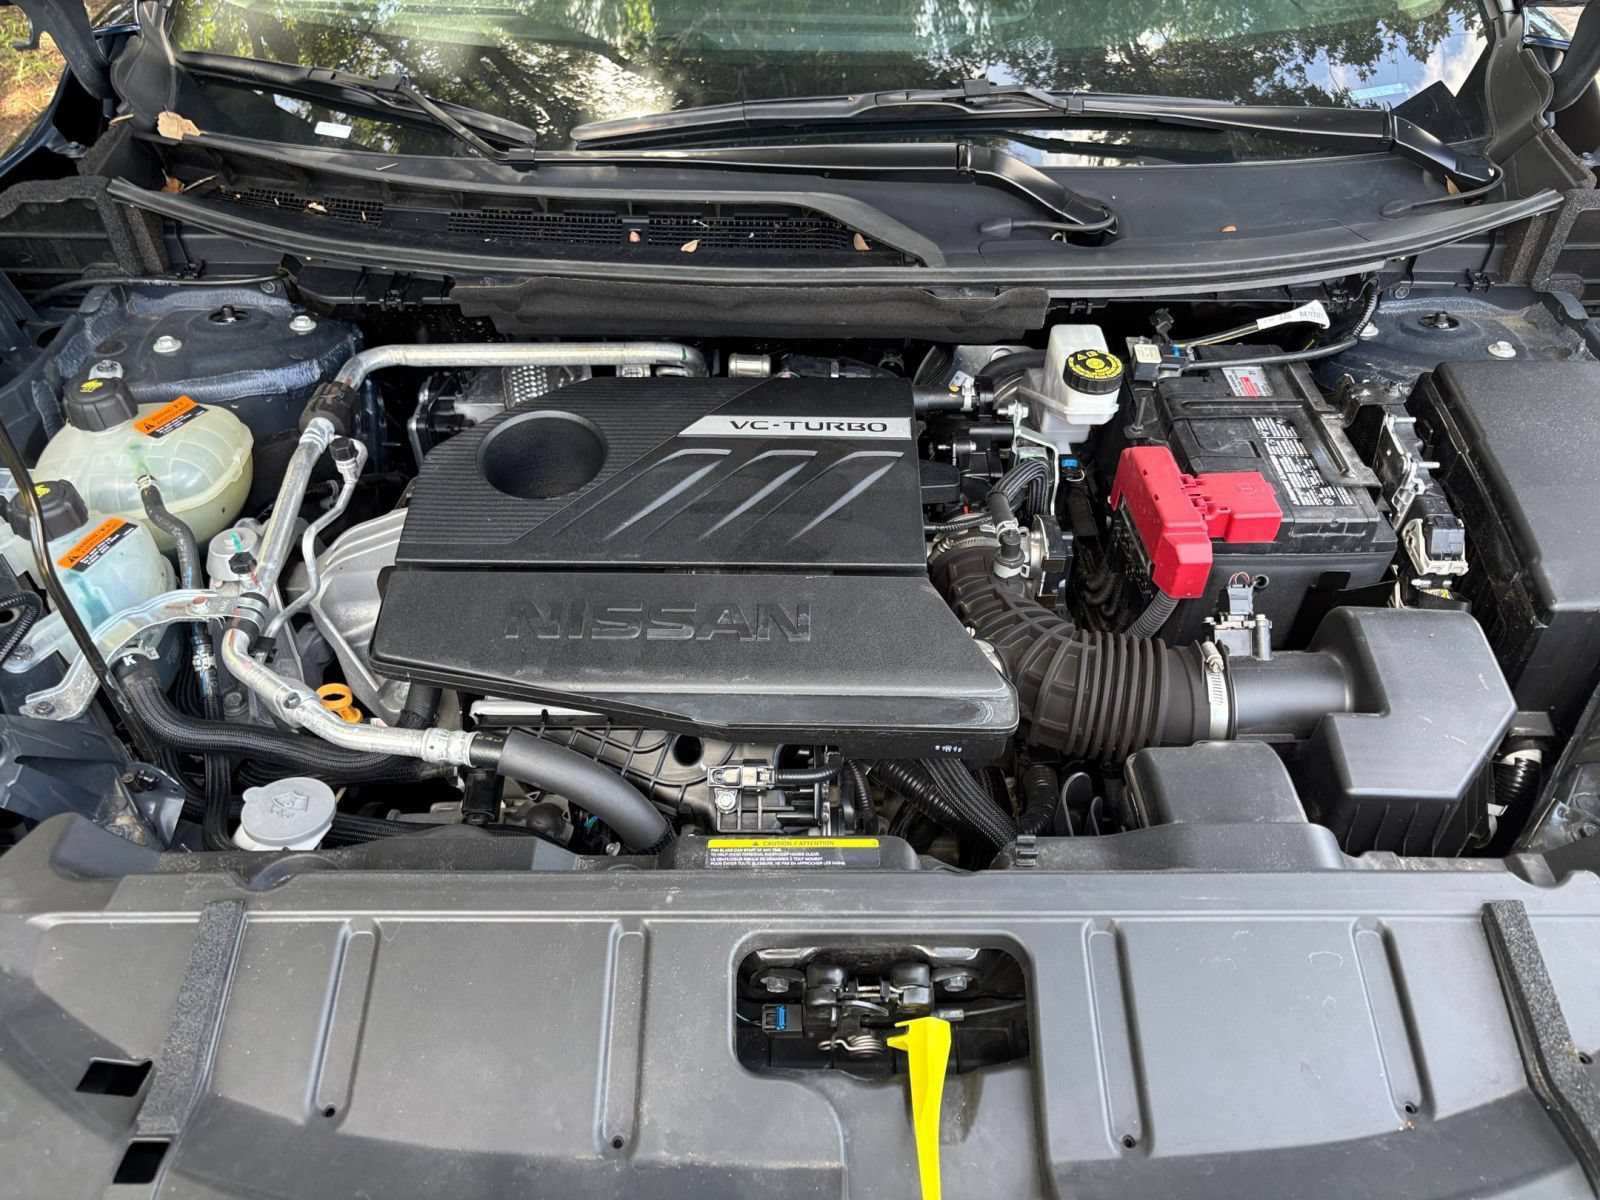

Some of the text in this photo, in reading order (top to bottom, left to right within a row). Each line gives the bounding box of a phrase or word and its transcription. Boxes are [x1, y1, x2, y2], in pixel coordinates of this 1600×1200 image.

[729, 420, 888, 433] VC-TURBO
[504, 600, 811, 642] NISSAN
[122, 654, 137, 667] K
